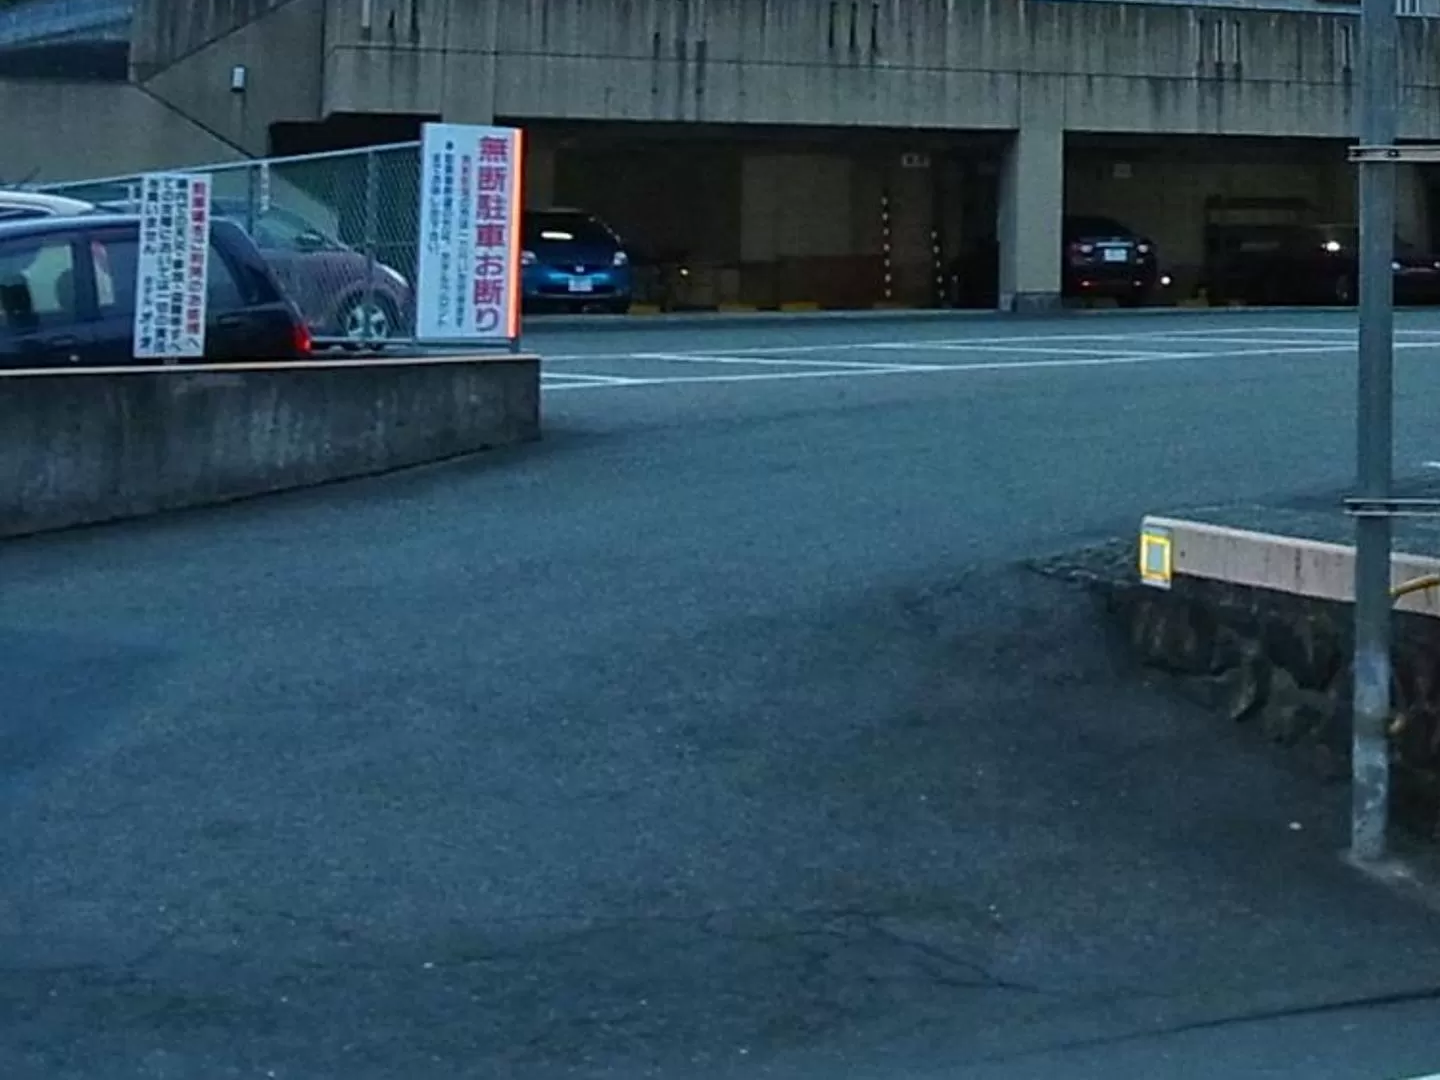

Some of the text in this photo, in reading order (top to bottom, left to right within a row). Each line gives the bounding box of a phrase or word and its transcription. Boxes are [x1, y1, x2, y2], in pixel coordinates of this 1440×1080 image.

[473, 135, 508, 333] 無断駐車お断り
